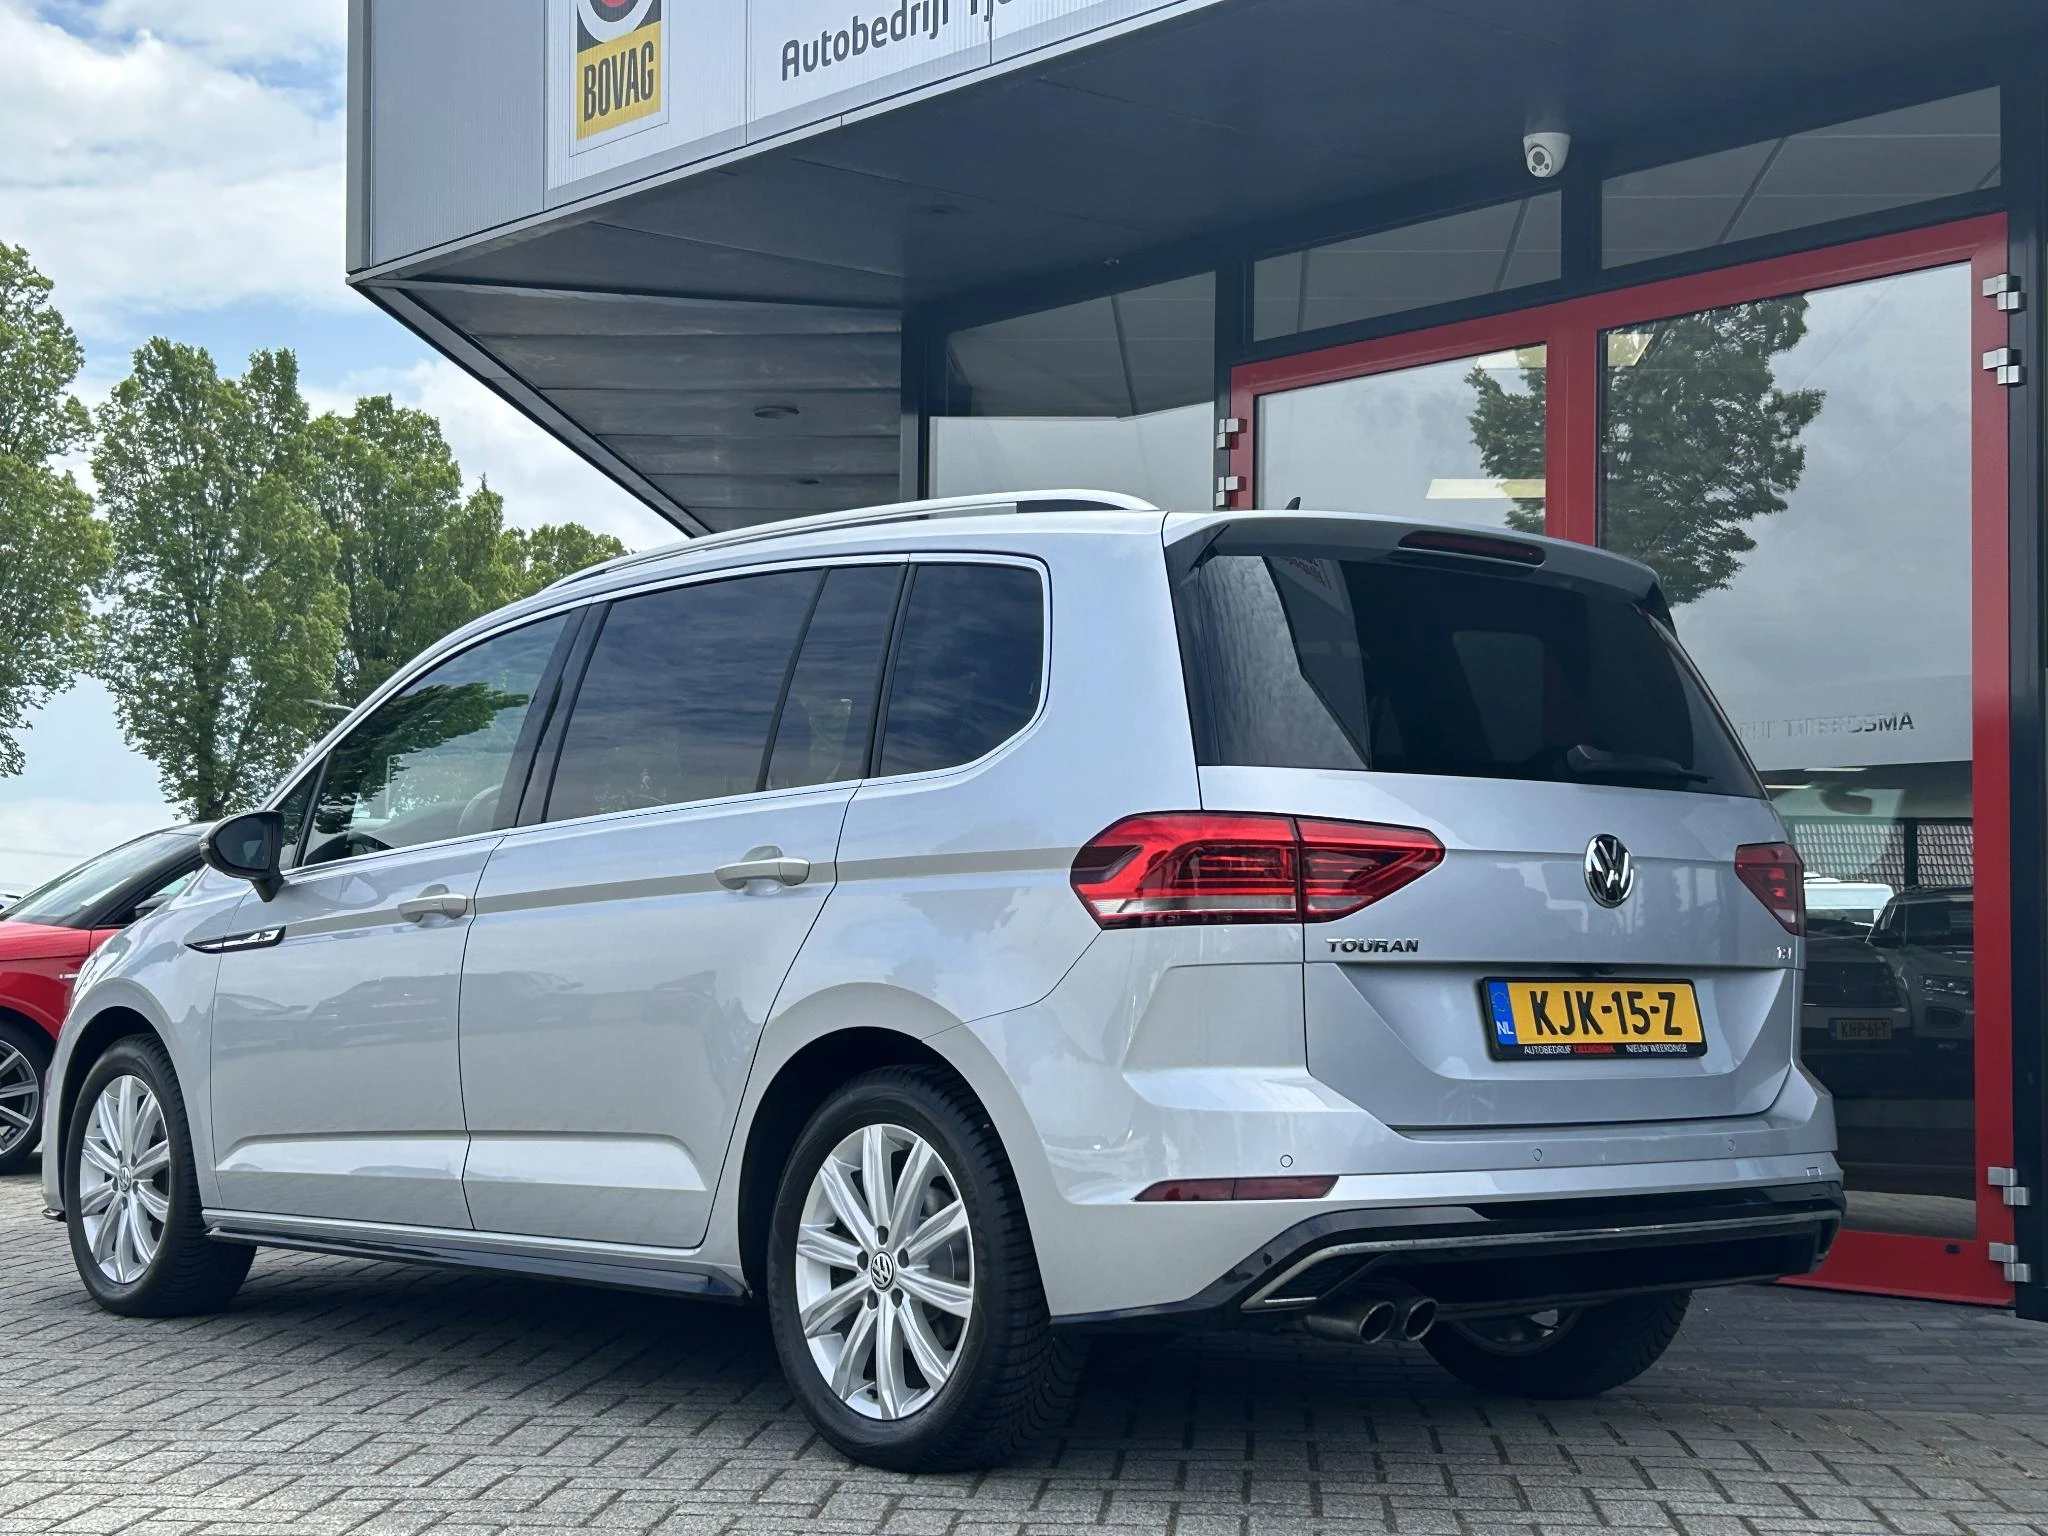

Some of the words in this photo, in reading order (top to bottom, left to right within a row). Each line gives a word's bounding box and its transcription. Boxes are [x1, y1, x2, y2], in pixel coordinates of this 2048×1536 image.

[583, 41, 655, 122] BOVAG
[1326, 938, 1420, 953] TOURAN
[1496, 1021, 1515, 1035] NL
[1529, 991, 1683, 1036] KJK-15-Z
